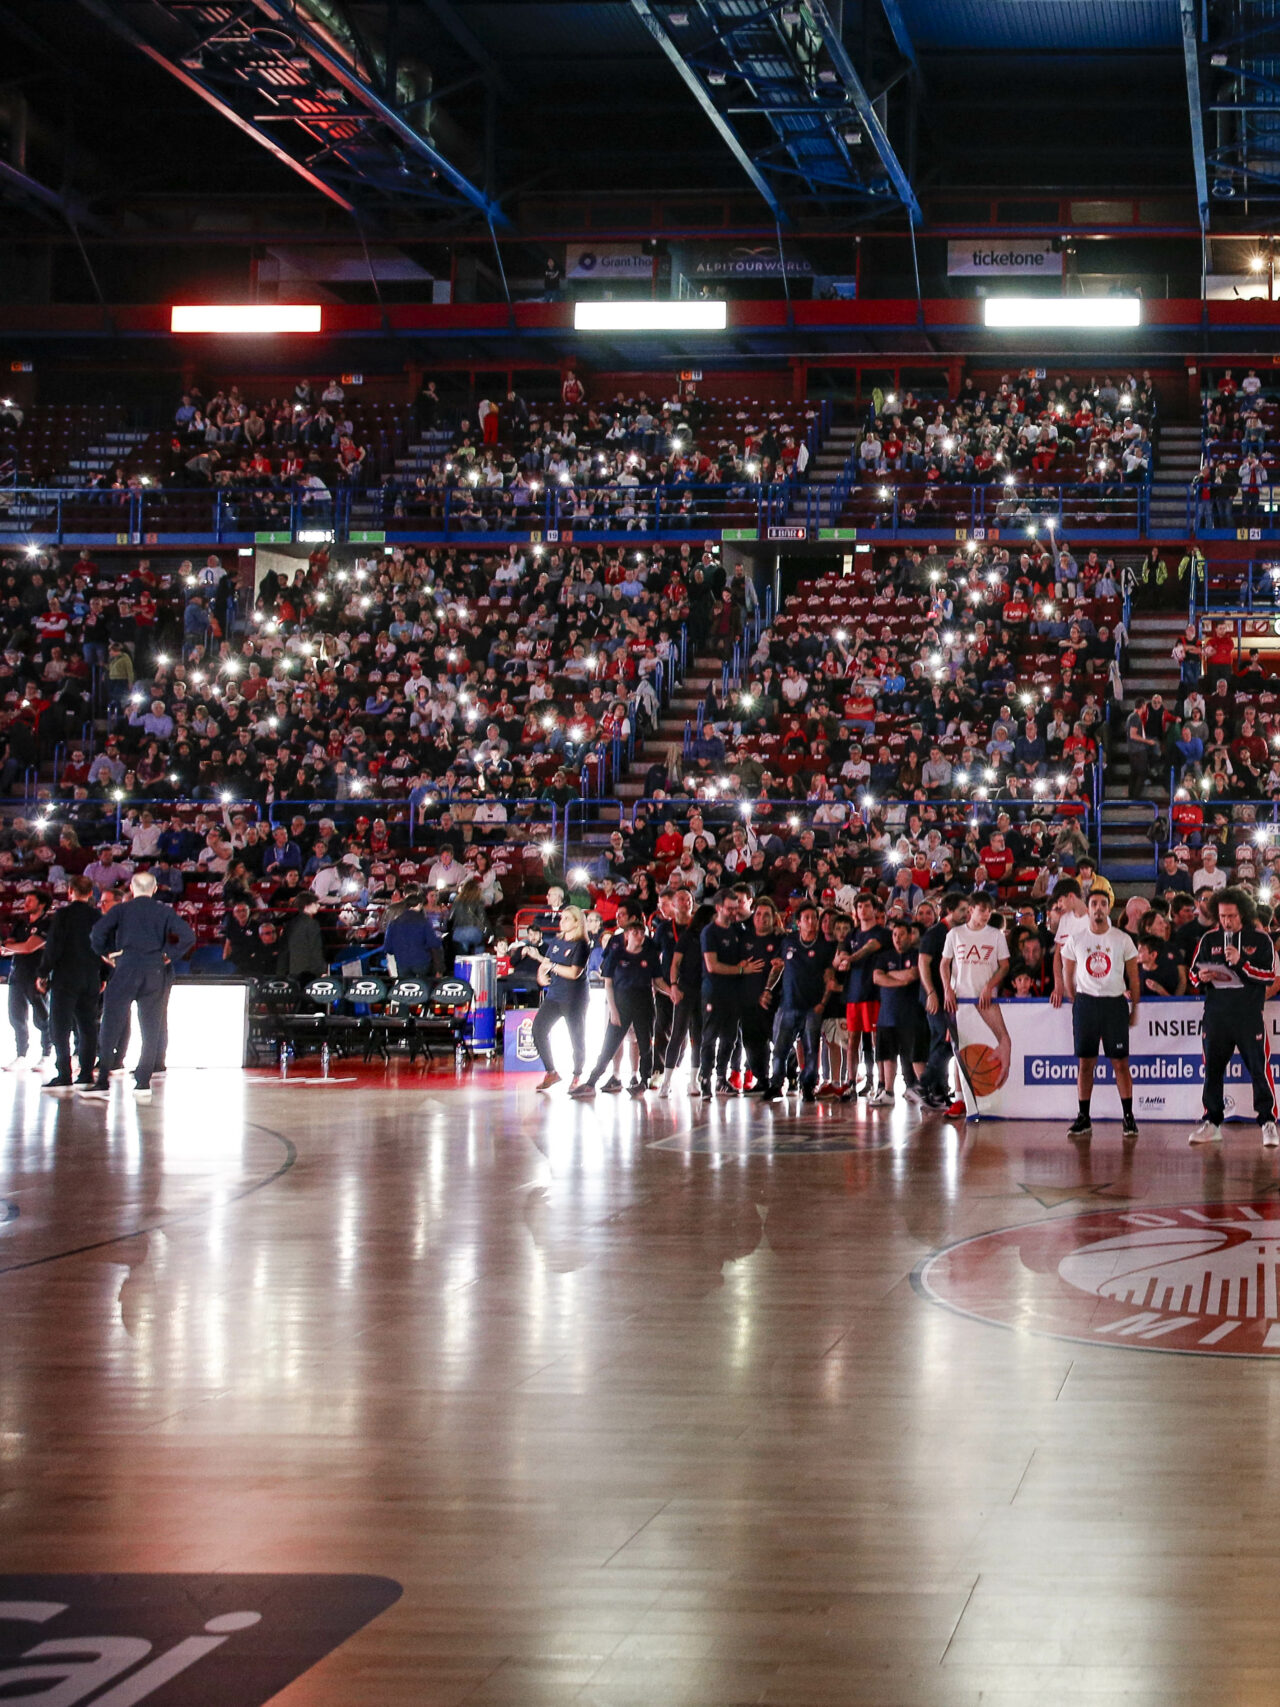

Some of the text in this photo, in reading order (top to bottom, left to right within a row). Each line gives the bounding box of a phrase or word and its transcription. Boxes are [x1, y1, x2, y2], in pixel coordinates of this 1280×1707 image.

[601, 255, 652, 268] Grant Tho
[973, 251, 1044, 266] ticketone
[957, 944, 994, 961] EA7
[1149, 1020, 1201, 1036] INSIE
[1112, 1058, 1193, 1079] ondiale
